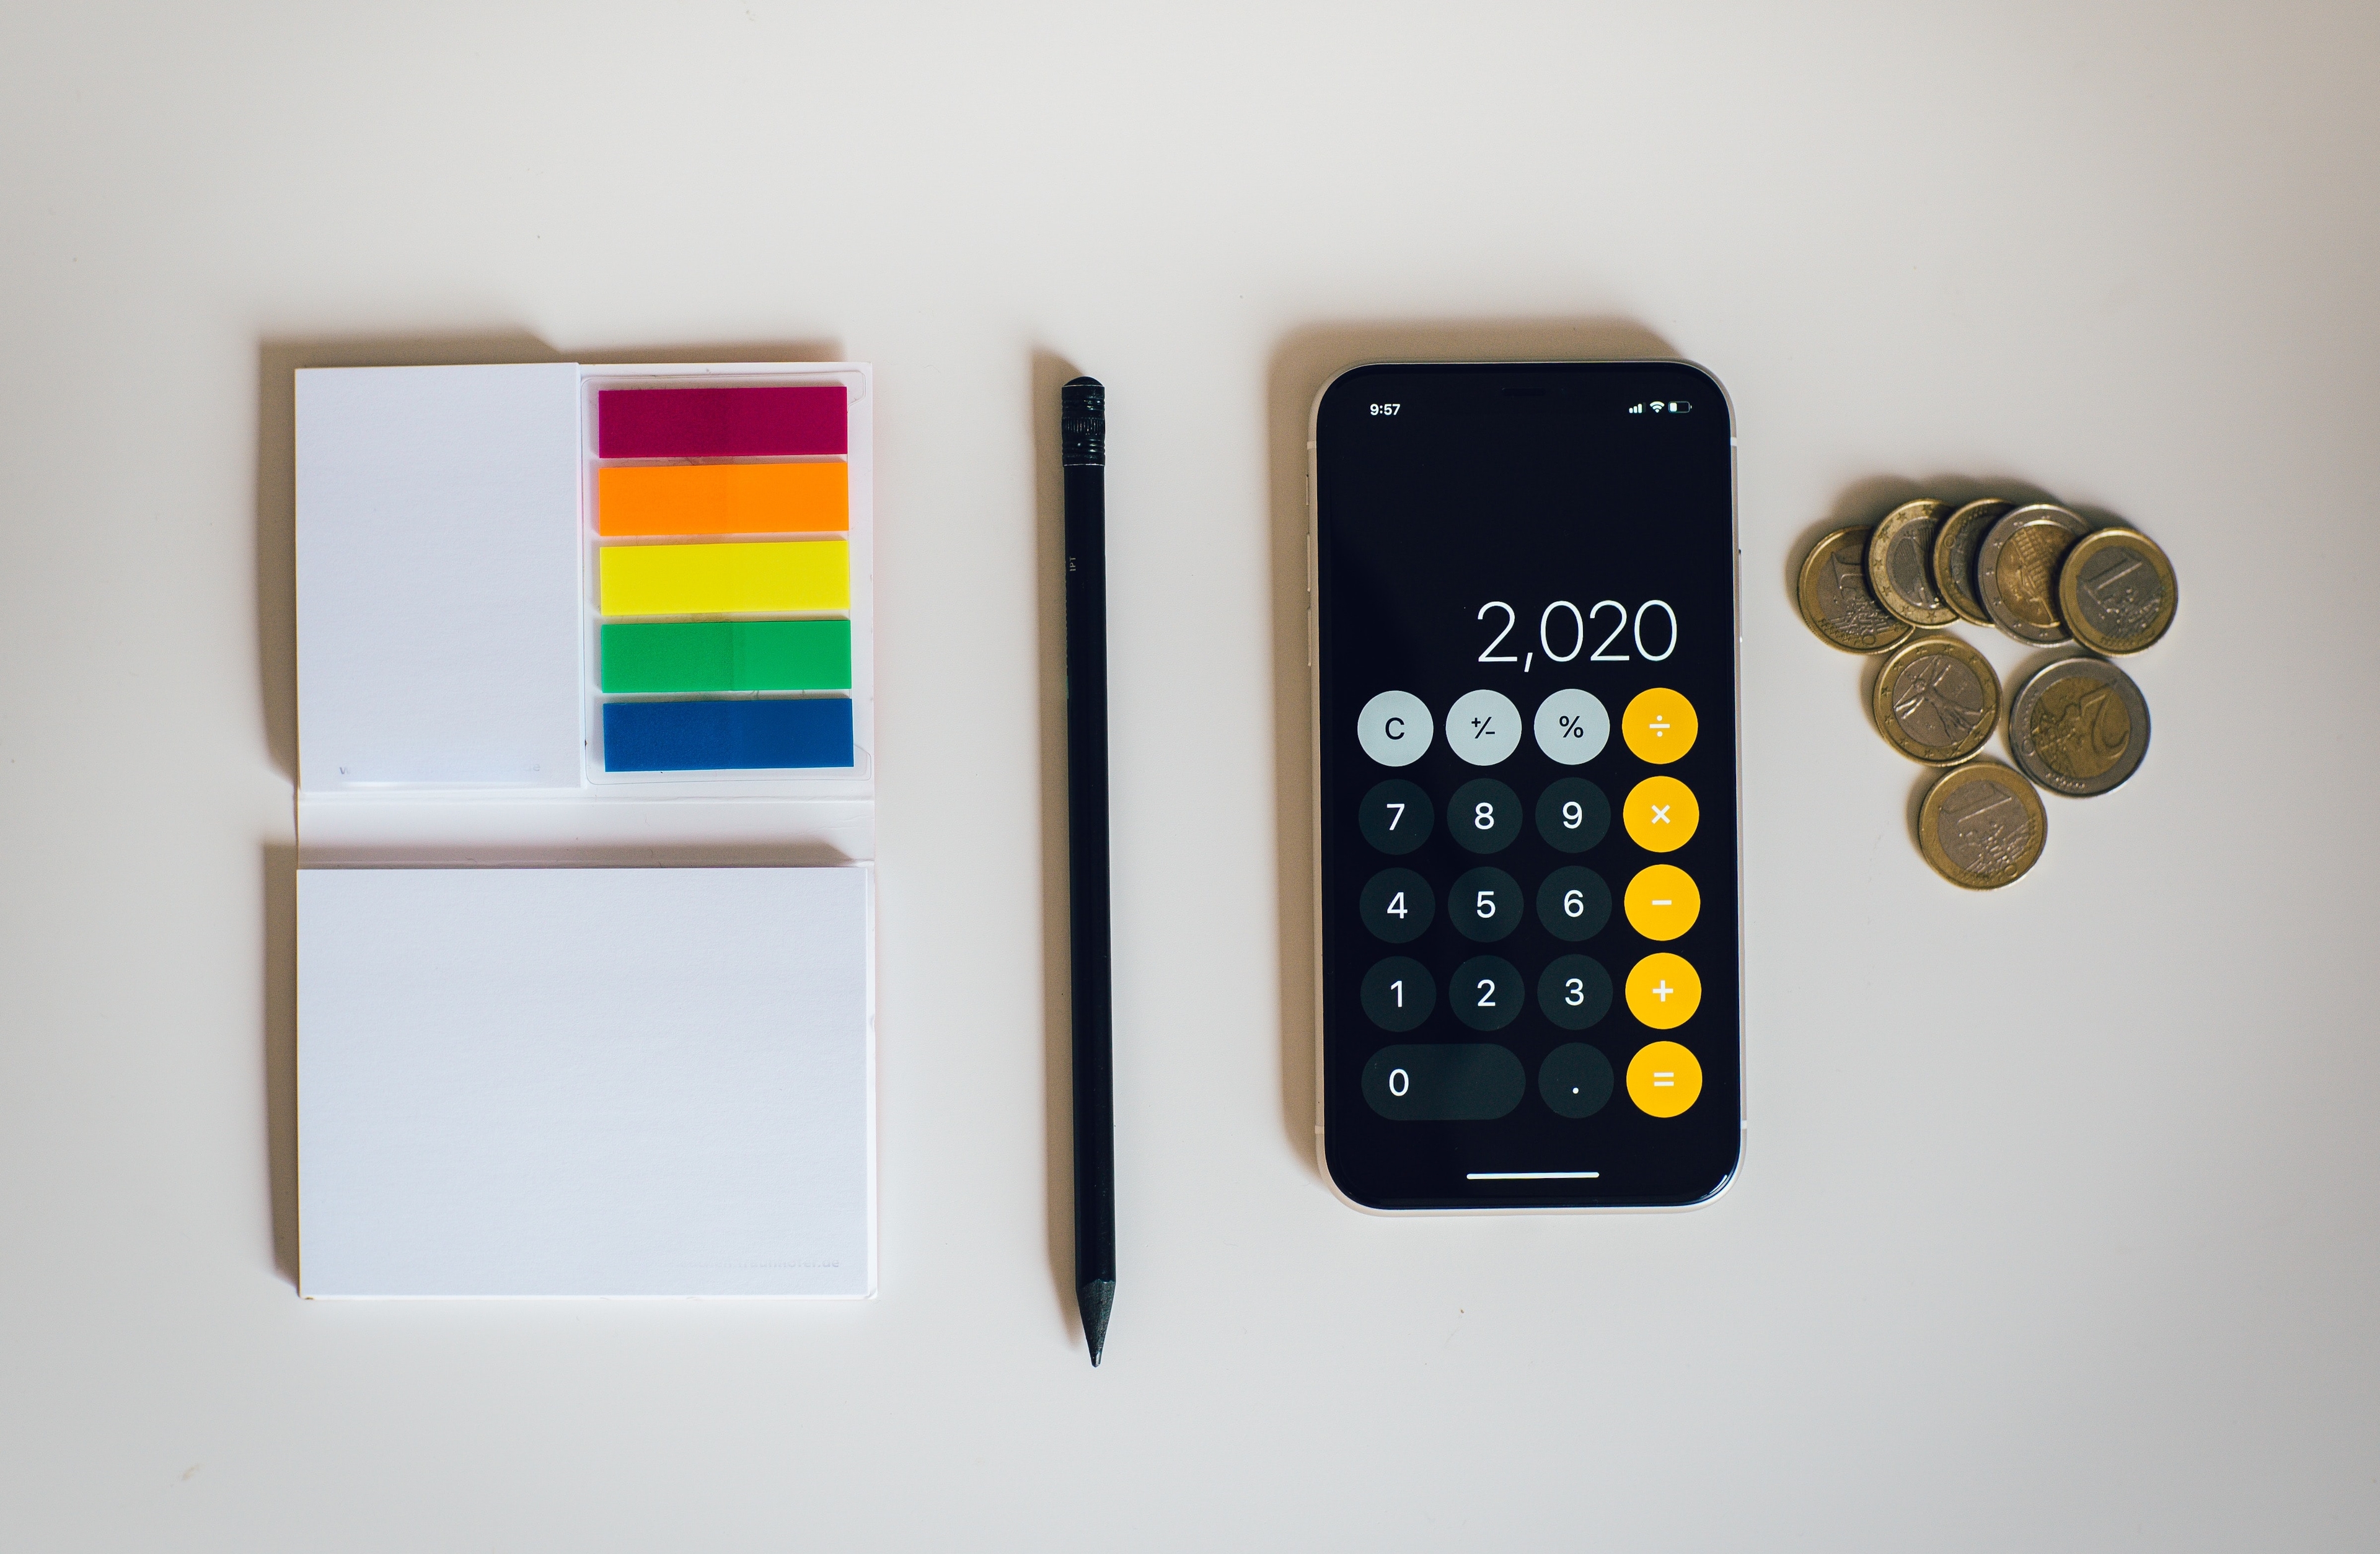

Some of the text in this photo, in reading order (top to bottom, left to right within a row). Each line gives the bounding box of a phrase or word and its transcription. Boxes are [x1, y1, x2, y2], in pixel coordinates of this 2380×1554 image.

[1370, 403, 1401, 416] 9:57
[1477, 599, 1677, 673] 2,020
[1385, 717, 1405, 740] C
[1559, 715, 1584, 739] %
[1386, 803, 1405, 831] 7
[1474, 802, 1494, 830] 8
[1562, 801, 1582, 829] 9
[1386, 892, 1408, 919] 4
[1476, 890, 1496, 918] 5
[1564, 889, 1584, 918] 6
[1390, 980, 1403, 1007] 1
[1477, 979, 1496, 1007] 2
[1565, 978, 1584, 1006] 3
[1389, 1068, 1409, 1097] 0
